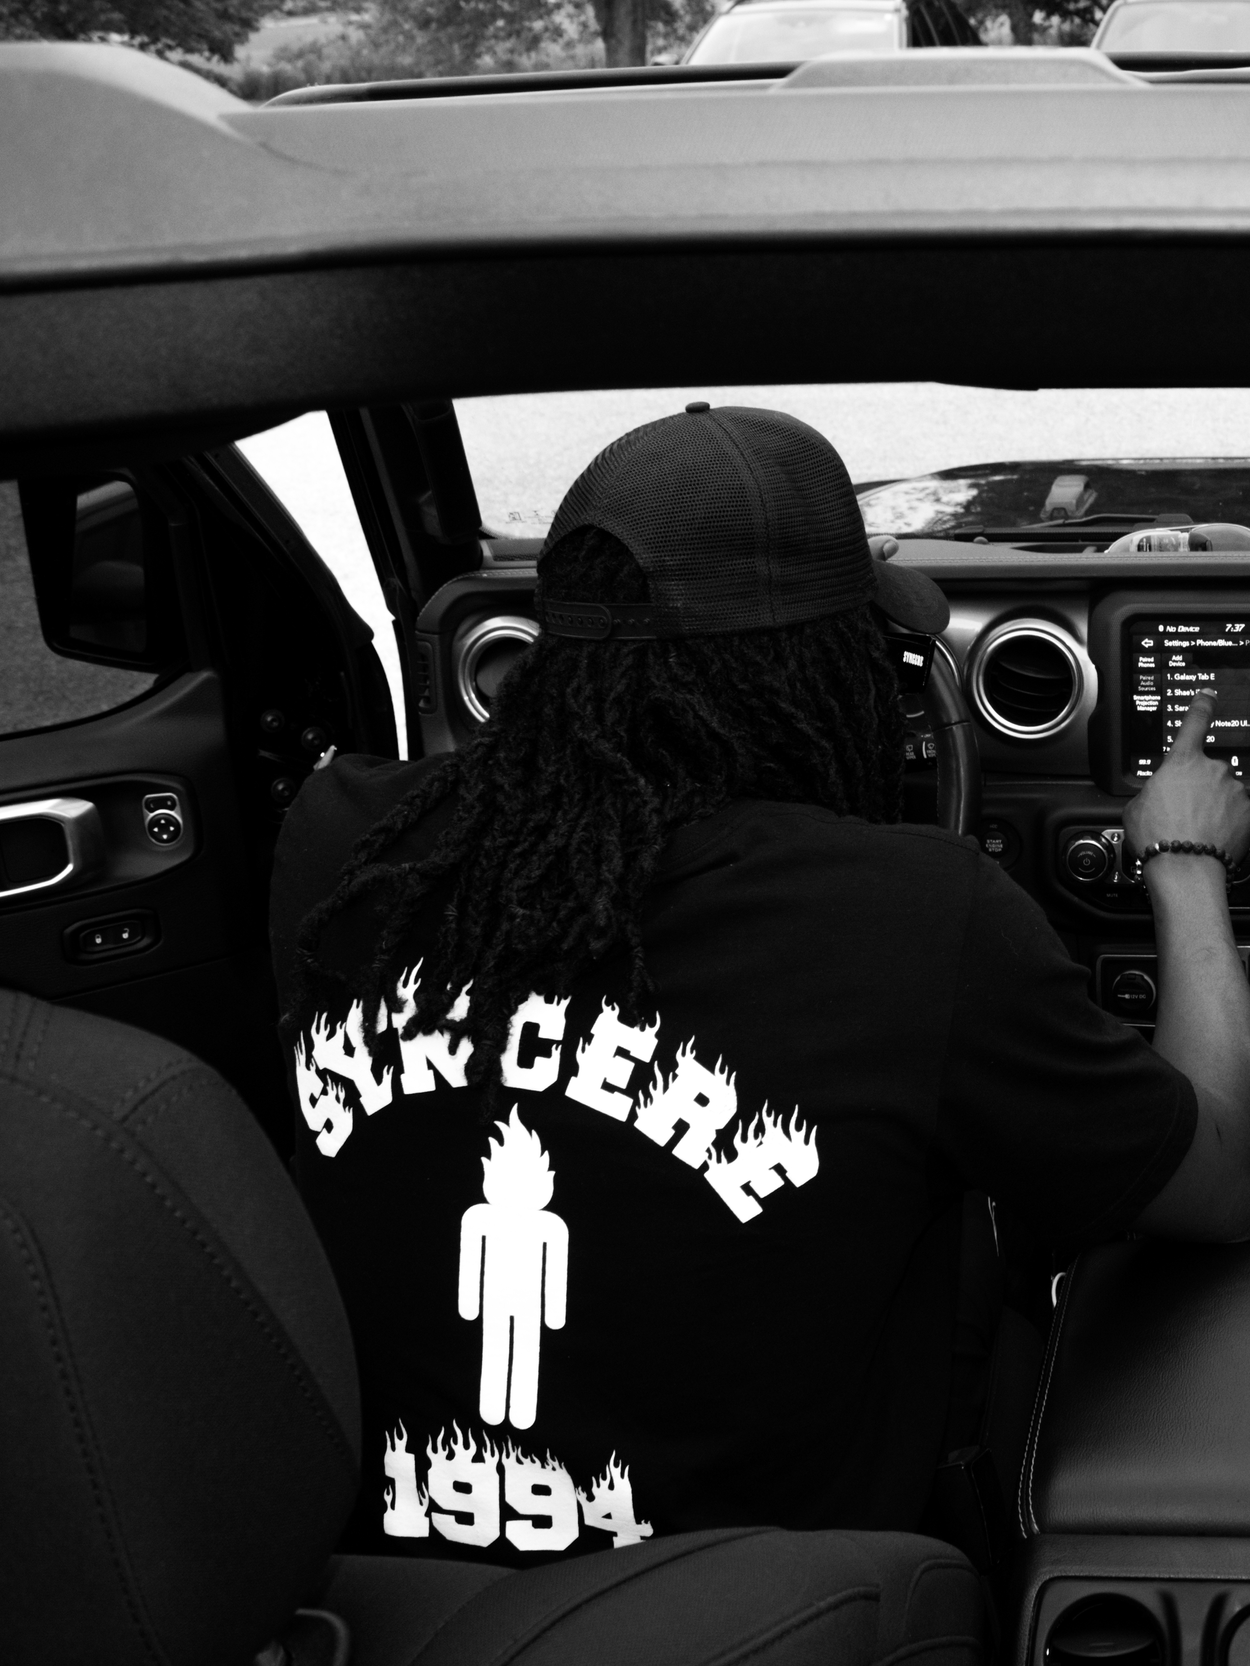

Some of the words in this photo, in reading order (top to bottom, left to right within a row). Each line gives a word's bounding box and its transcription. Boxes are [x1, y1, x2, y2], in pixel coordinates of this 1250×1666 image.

[1225, 623, 1246, 632] 7:37
[1164, 639, 1190, 648] Settings
[1174, 672, 1197, 681] Galaxy
[1197, 672, 1209, 680] Tab
[1166, 688, 1173, 696] 2.
[1166, 704, 1173, 712] 3.
[1166, 720, 1173, 728] 4.
[1166, 735, 1173, 743] 5.
[384, 1418, 654, 1551] 1994
